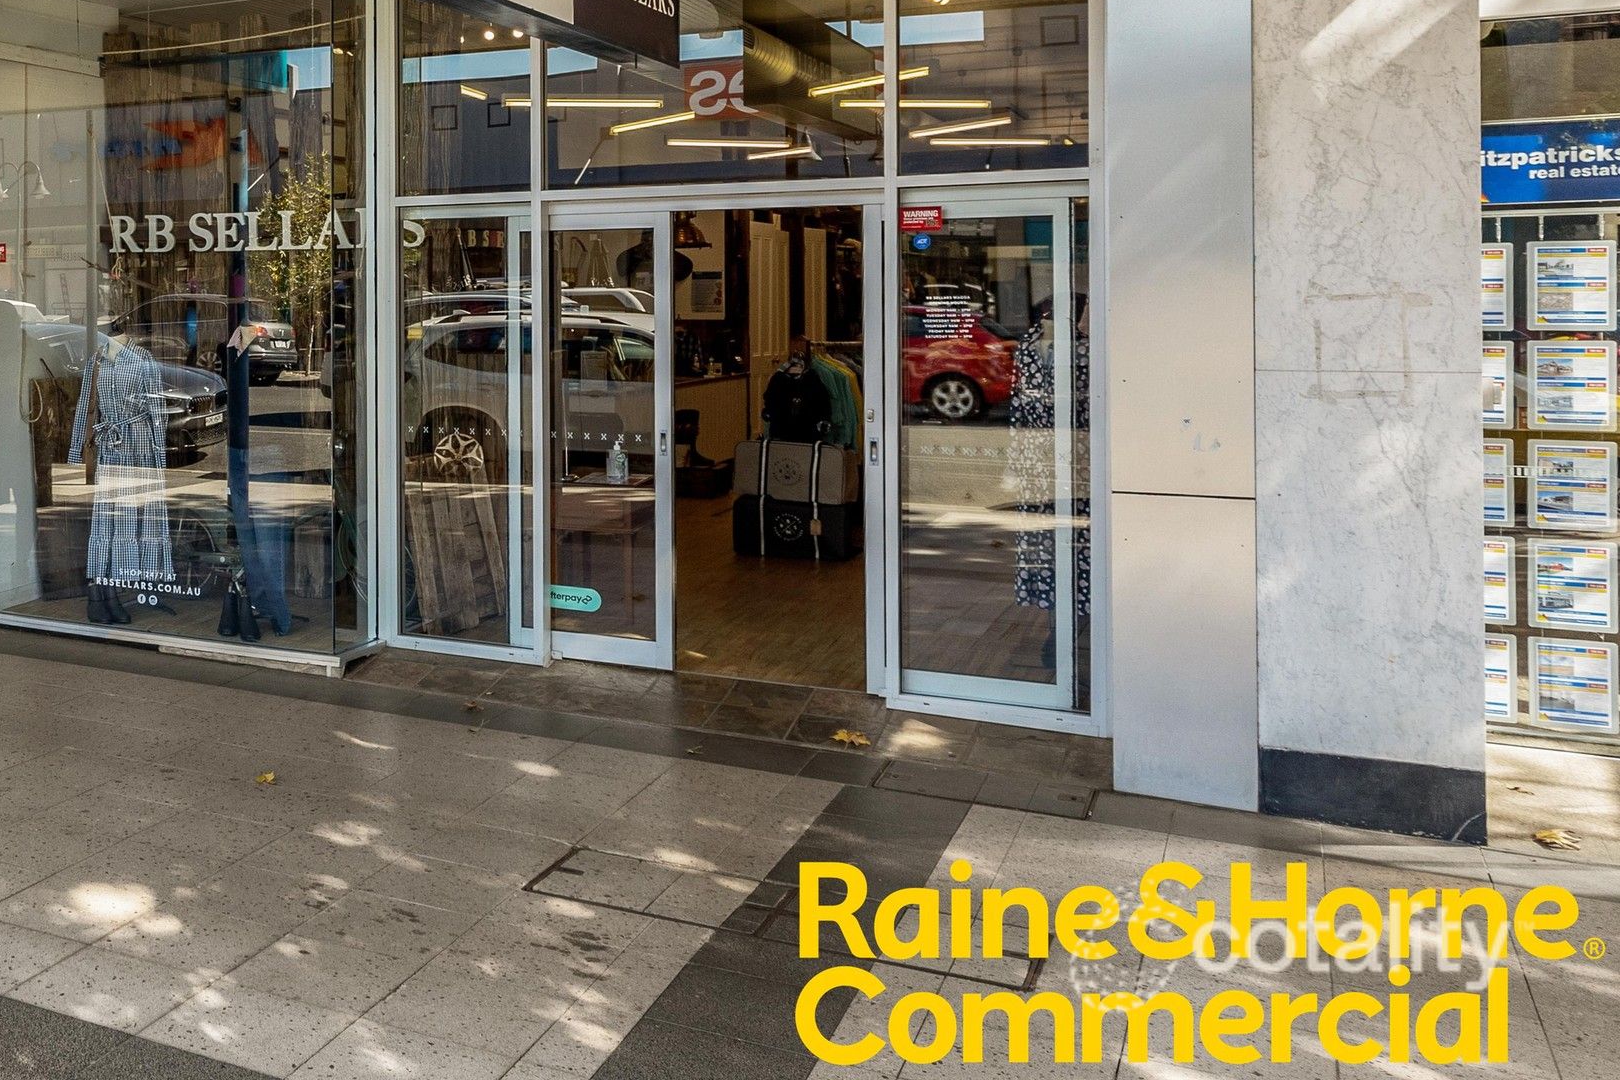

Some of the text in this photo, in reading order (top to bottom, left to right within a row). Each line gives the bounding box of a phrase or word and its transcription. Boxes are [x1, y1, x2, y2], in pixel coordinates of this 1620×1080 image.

[1480, 145, 1620, 170] itzpatrick
[1529, 164, 1620, 179] real estat
[903, 209, 939, 218] WARNING
[109, 214, 175, 253] RB
[119, 568, 141, 577] SHOP
[166, 573, 177, 581] AT
[96, 576, 201, 597] RBSELLARS.COM.AU
[550, 591, 582, 604] fterpay
